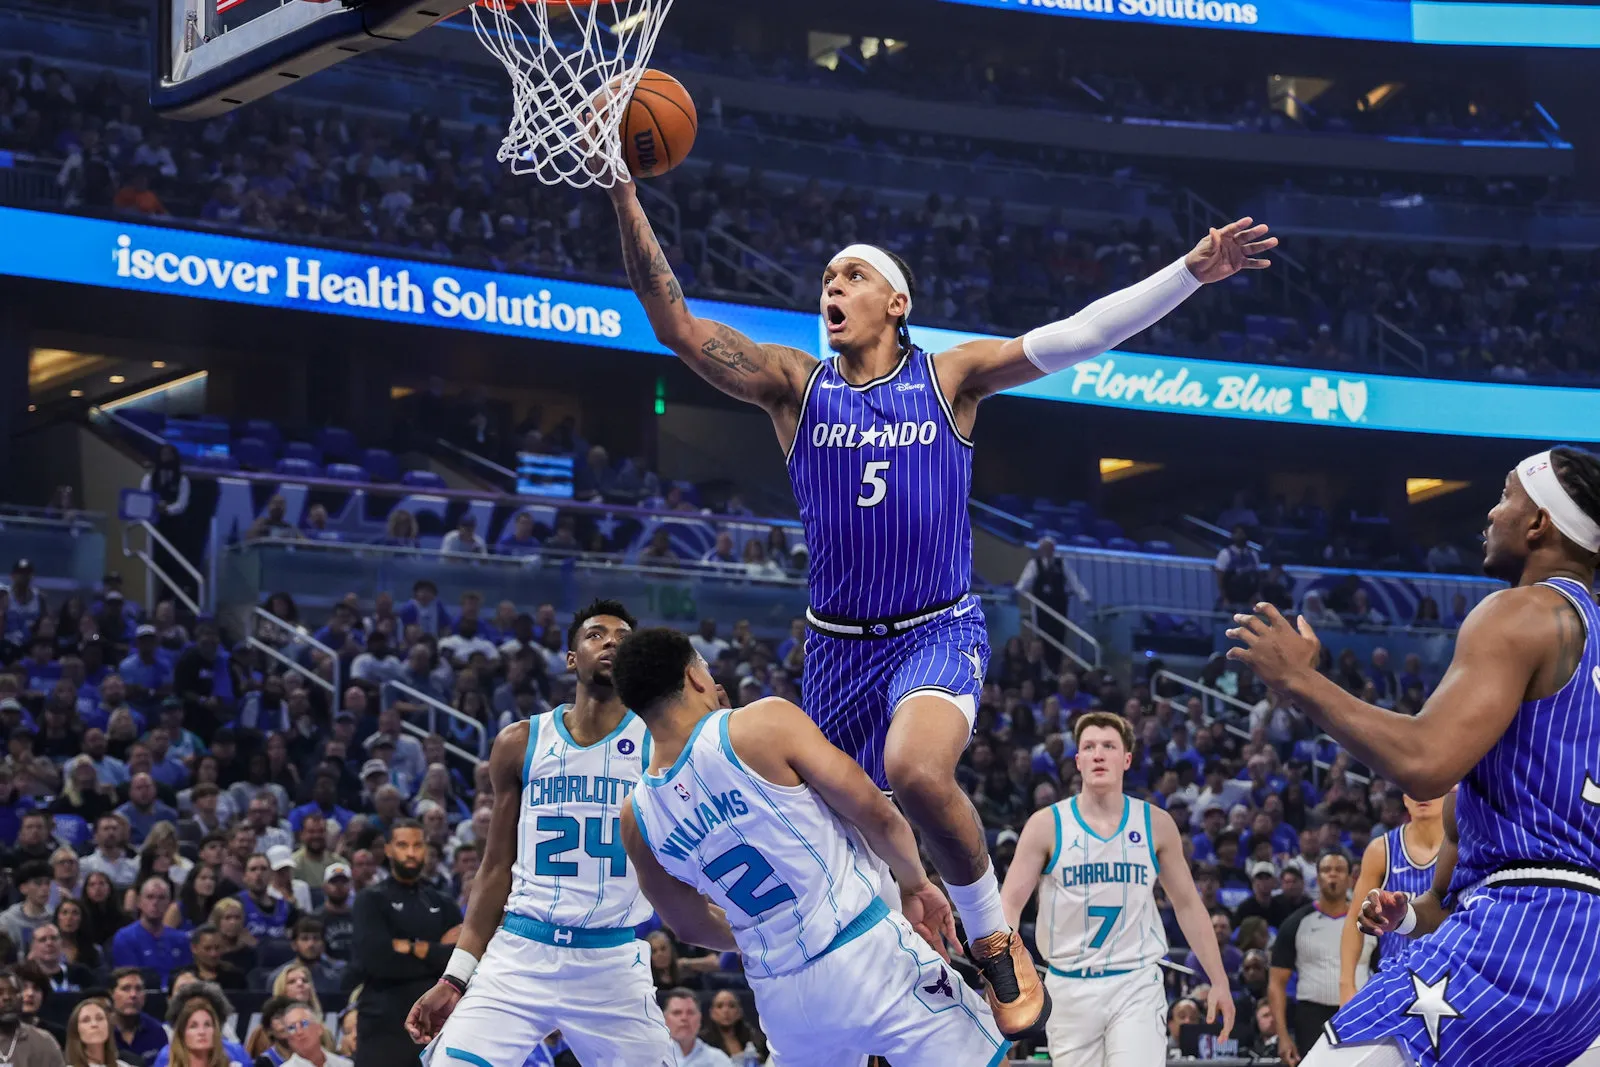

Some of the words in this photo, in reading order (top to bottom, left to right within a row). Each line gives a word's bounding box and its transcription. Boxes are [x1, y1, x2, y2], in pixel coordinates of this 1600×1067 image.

[1118, 0, 1258, 24] Solutions
[113, 234, 278, 294] iscover
[285, 256, 425, 314] Health
[432, 276, 622, 338] Solutions
[892, 382, 925, 392] Disney
[1071, 359, 1209, 408] Florida
[1212, 373, 1293, 415] Blue
[856, 460, 891, 507] 5
[535, 816, 627, 877] 24
[659, 789, 749, 862] WILLIAMS
[701, 843, 798, 918] 2
[1062, 862, 1148, 888] CHARLOTTE
[1087, 905, 1123, 949] 7
